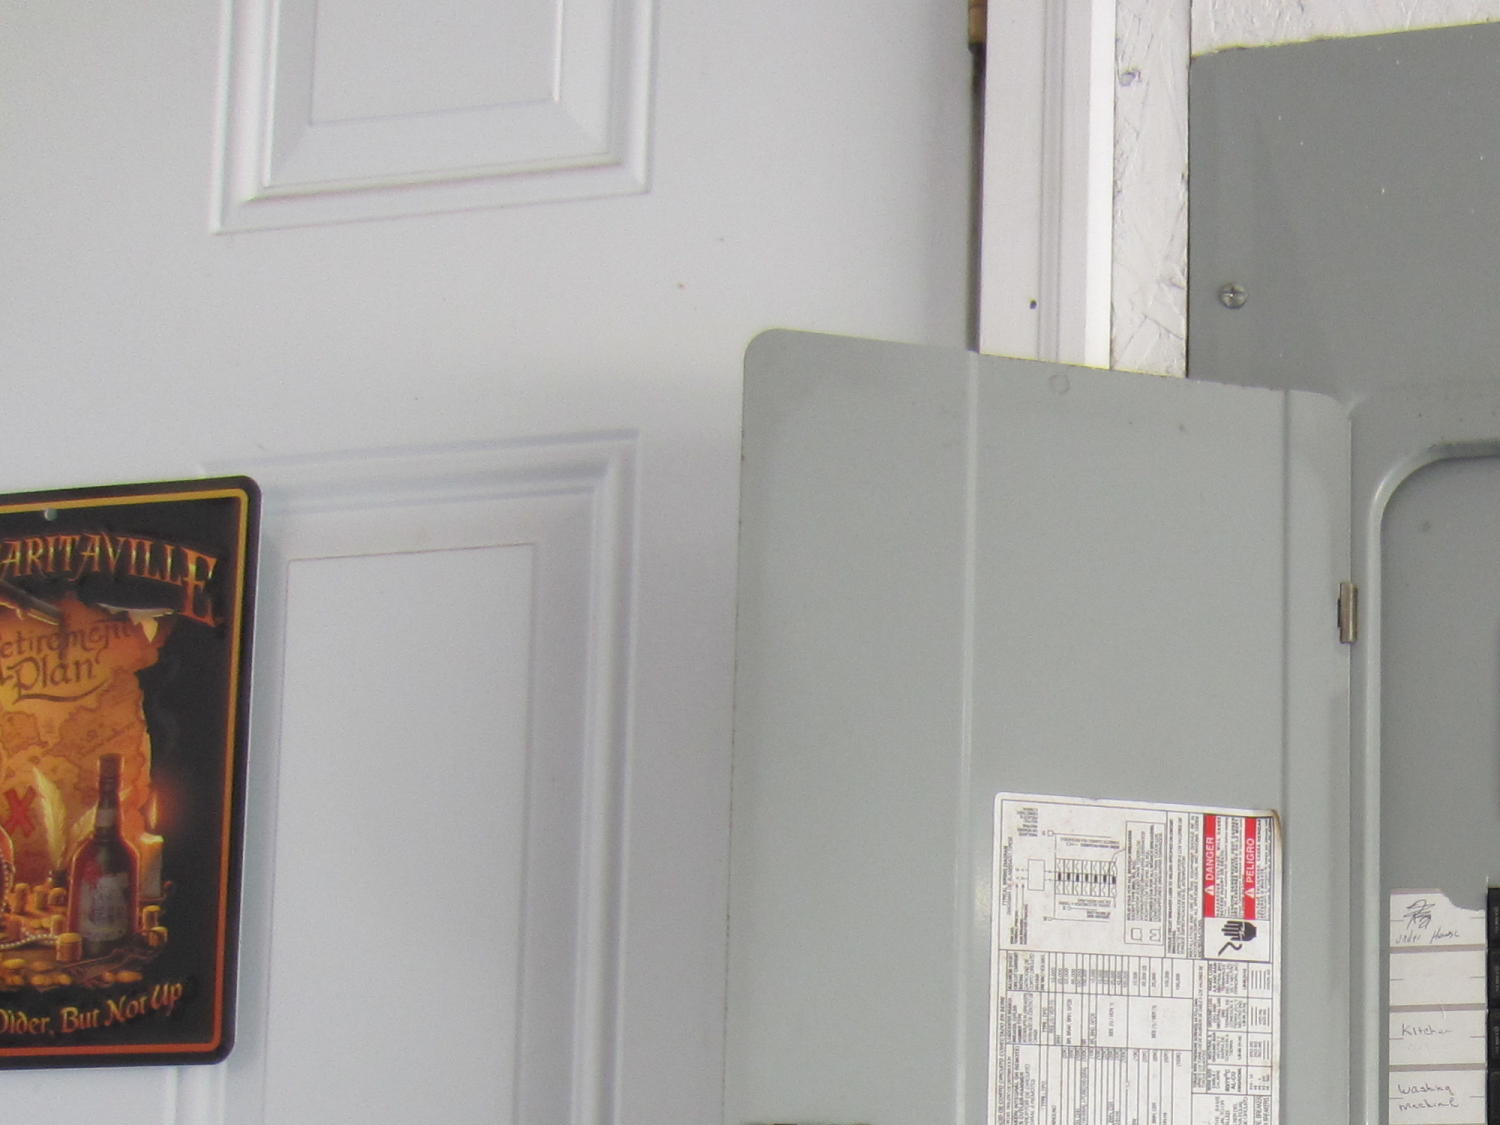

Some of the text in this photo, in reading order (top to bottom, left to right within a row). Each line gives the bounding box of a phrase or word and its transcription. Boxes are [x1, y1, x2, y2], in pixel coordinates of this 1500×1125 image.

[1246, 838, 1254, 882] PELIGRO
[61, 1006, 99, 1033] But
[104, 995, 148, 1026] Not
[151, 982, 183, 1016] Up
